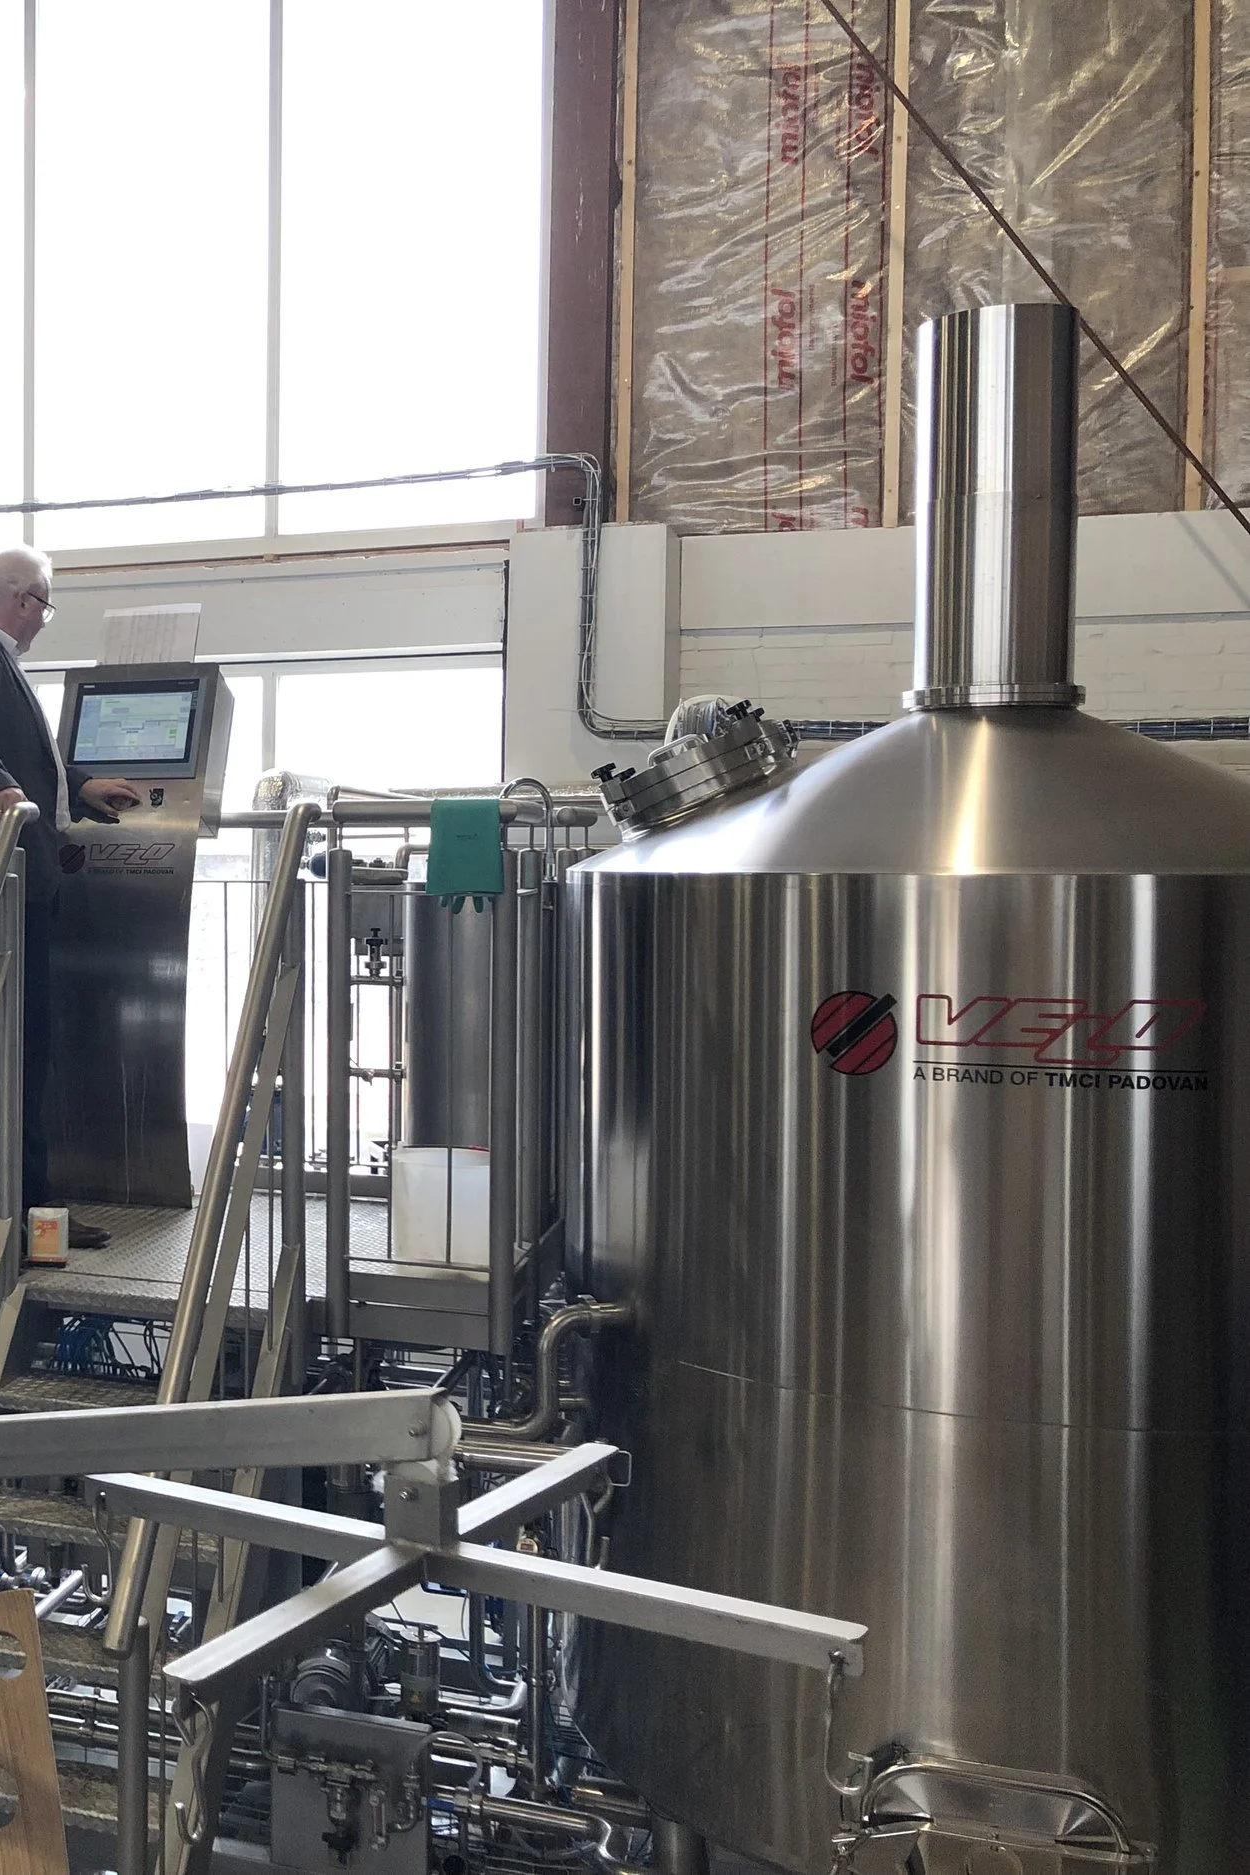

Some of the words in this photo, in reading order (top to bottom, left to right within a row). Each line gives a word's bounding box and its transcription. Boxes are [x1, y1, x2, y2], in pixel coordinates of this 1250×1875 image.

[771, 288, 796, 392] miofol
[851, 280, 875, 384] miofol
[90, 843, 175, 866] VELO
[915, 993, 1207, 1065] VELO
[913, 1066, 927, 1081] A
[932, 1067, 1004, 1084] BRAND
[1010, 1071, 1039, 1086] OF
[1044, 1072, 1100, 1089] TMCI
[1108, 1074, 1208, 1091] PADOVAN
